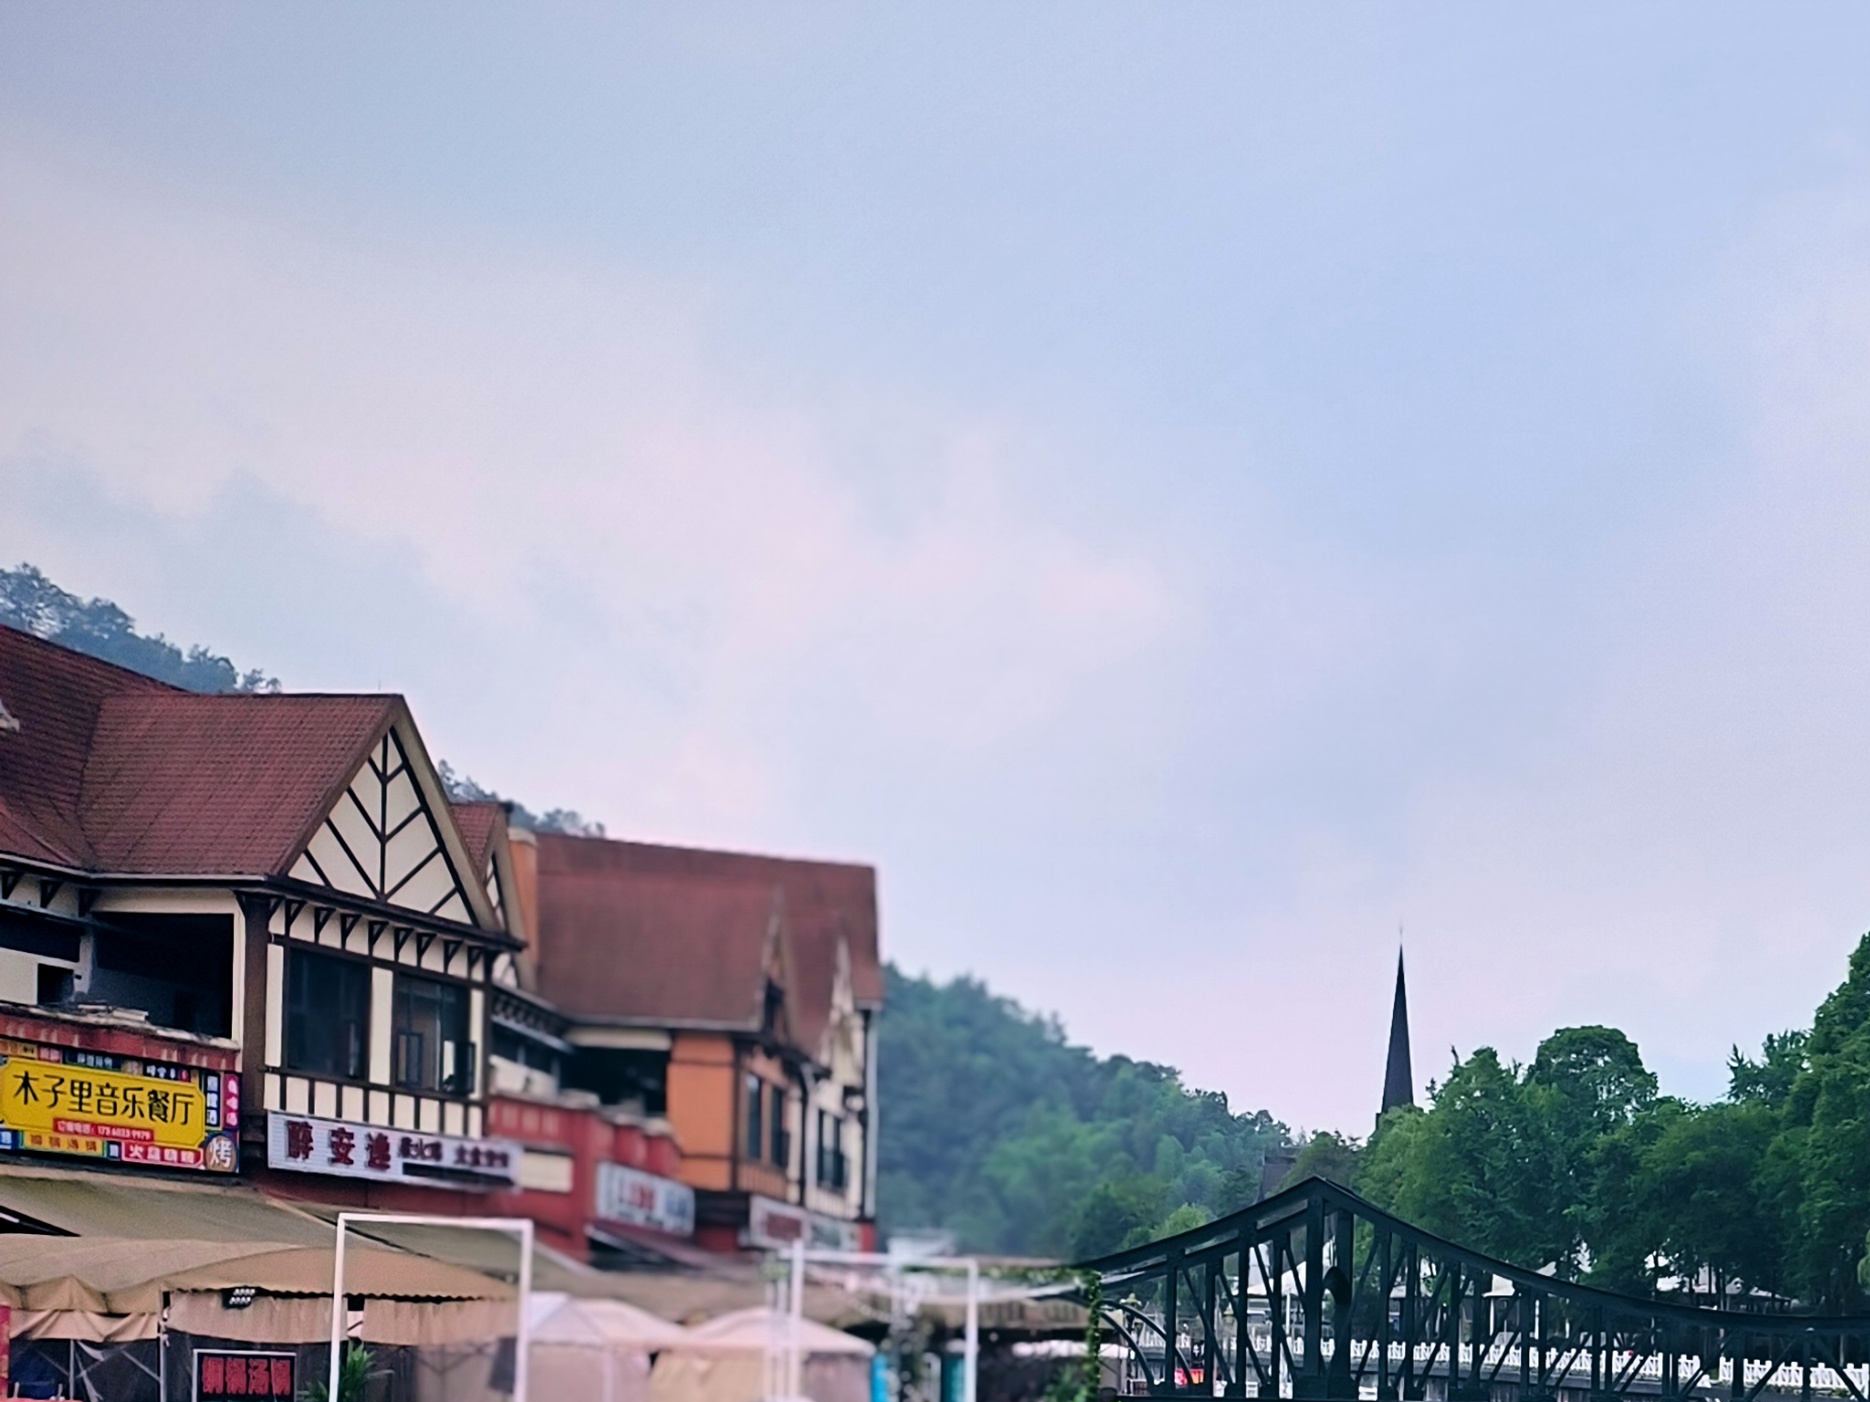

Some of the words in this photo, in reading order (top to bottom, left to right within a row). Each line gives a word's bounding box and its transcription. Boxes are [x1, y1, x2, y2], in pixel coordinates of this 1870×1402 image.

[12, 1069, 195, 1126] 木子里音乐餐厅
[210, 1137, 233, 1168] 烤
